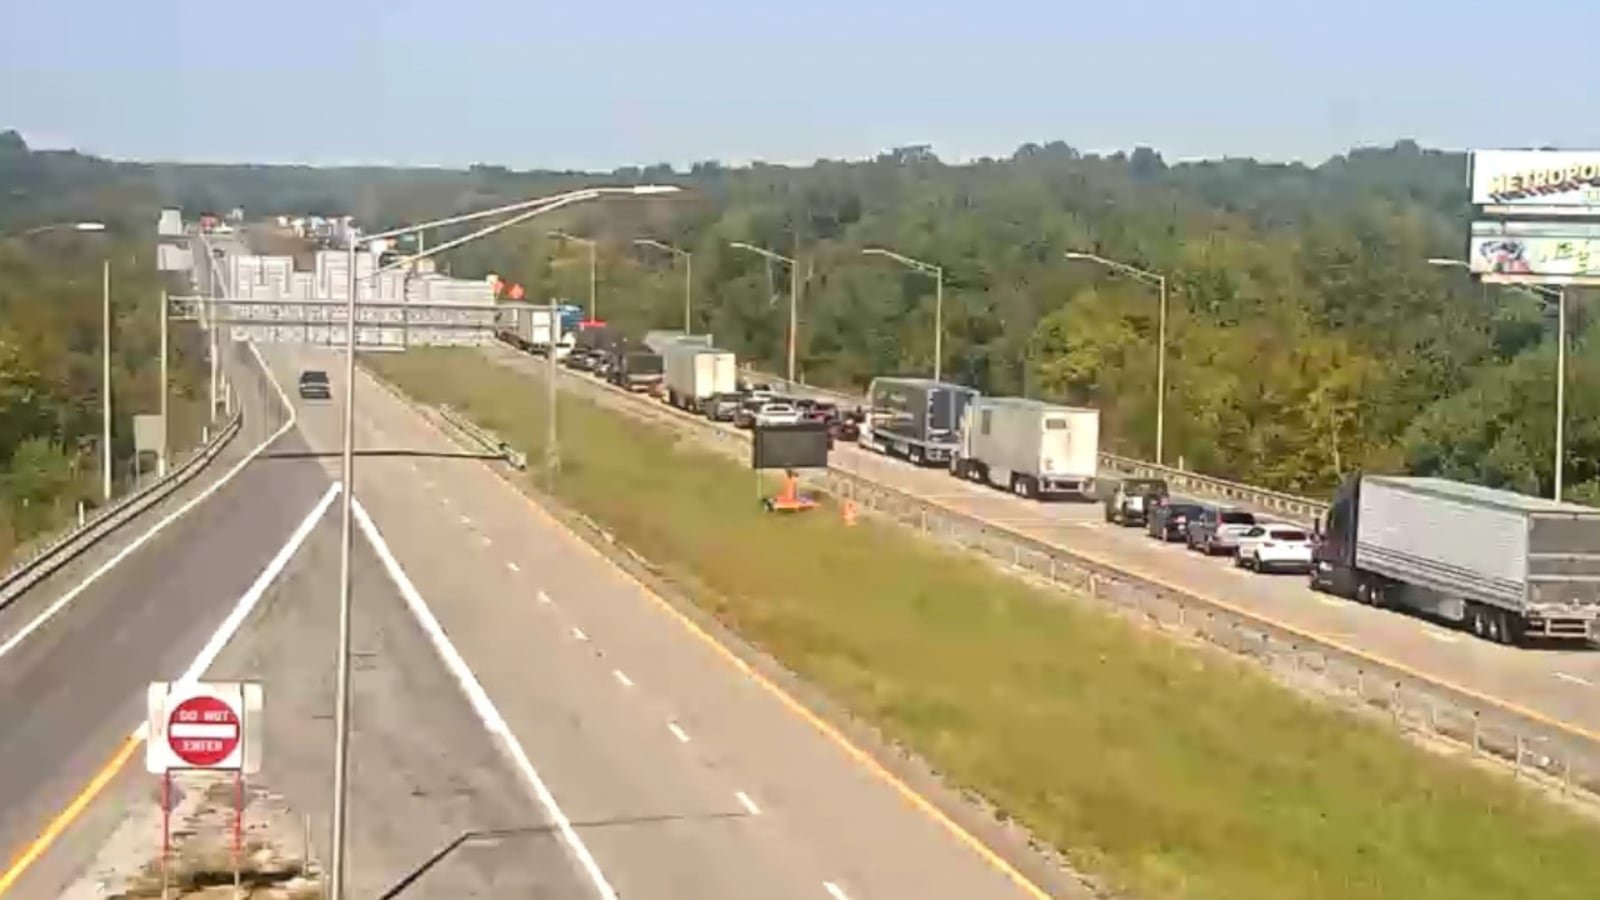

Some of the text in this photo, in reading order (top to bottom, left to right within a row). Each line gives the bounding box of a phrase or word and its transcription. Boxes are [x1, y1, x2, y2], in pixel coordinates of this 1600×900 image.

[1488, 164, 1600, 197] METROPO
[178, 710, 229, 721] DO NOT
